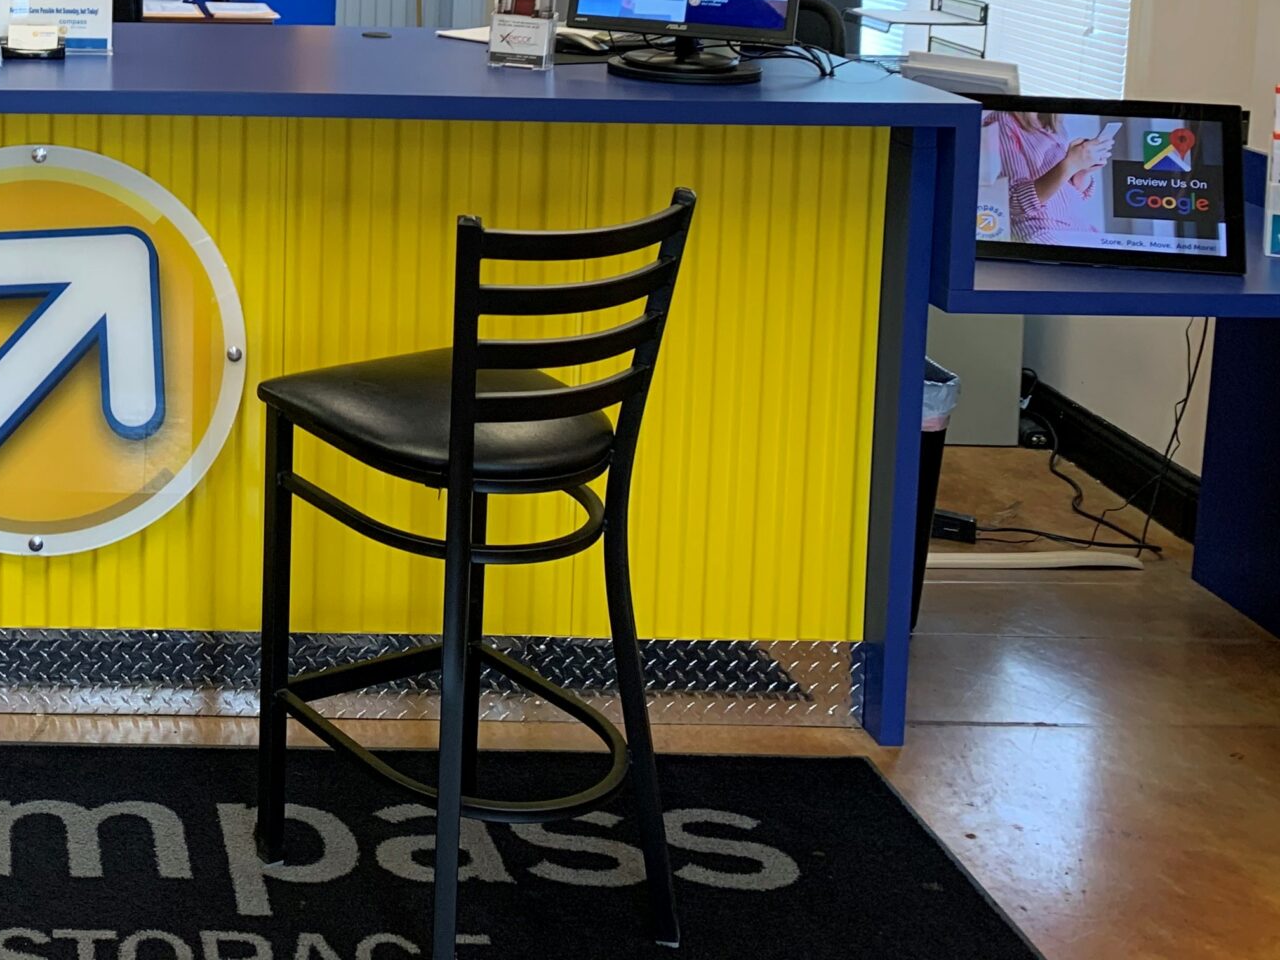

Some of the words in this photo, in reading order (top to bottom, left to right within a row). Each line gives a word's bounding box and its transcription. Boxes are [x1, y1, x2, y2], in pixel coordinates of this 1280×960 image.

[1147, 133, 1162, 146] G
[1127, 176, 1167, 188] Review
[1171, 179, 1187, 189] Us
[1190, 180, 1207, 189] On
[1126, 189, 1209, 215] Google
[1101, 238, 1123, 246] Store.
